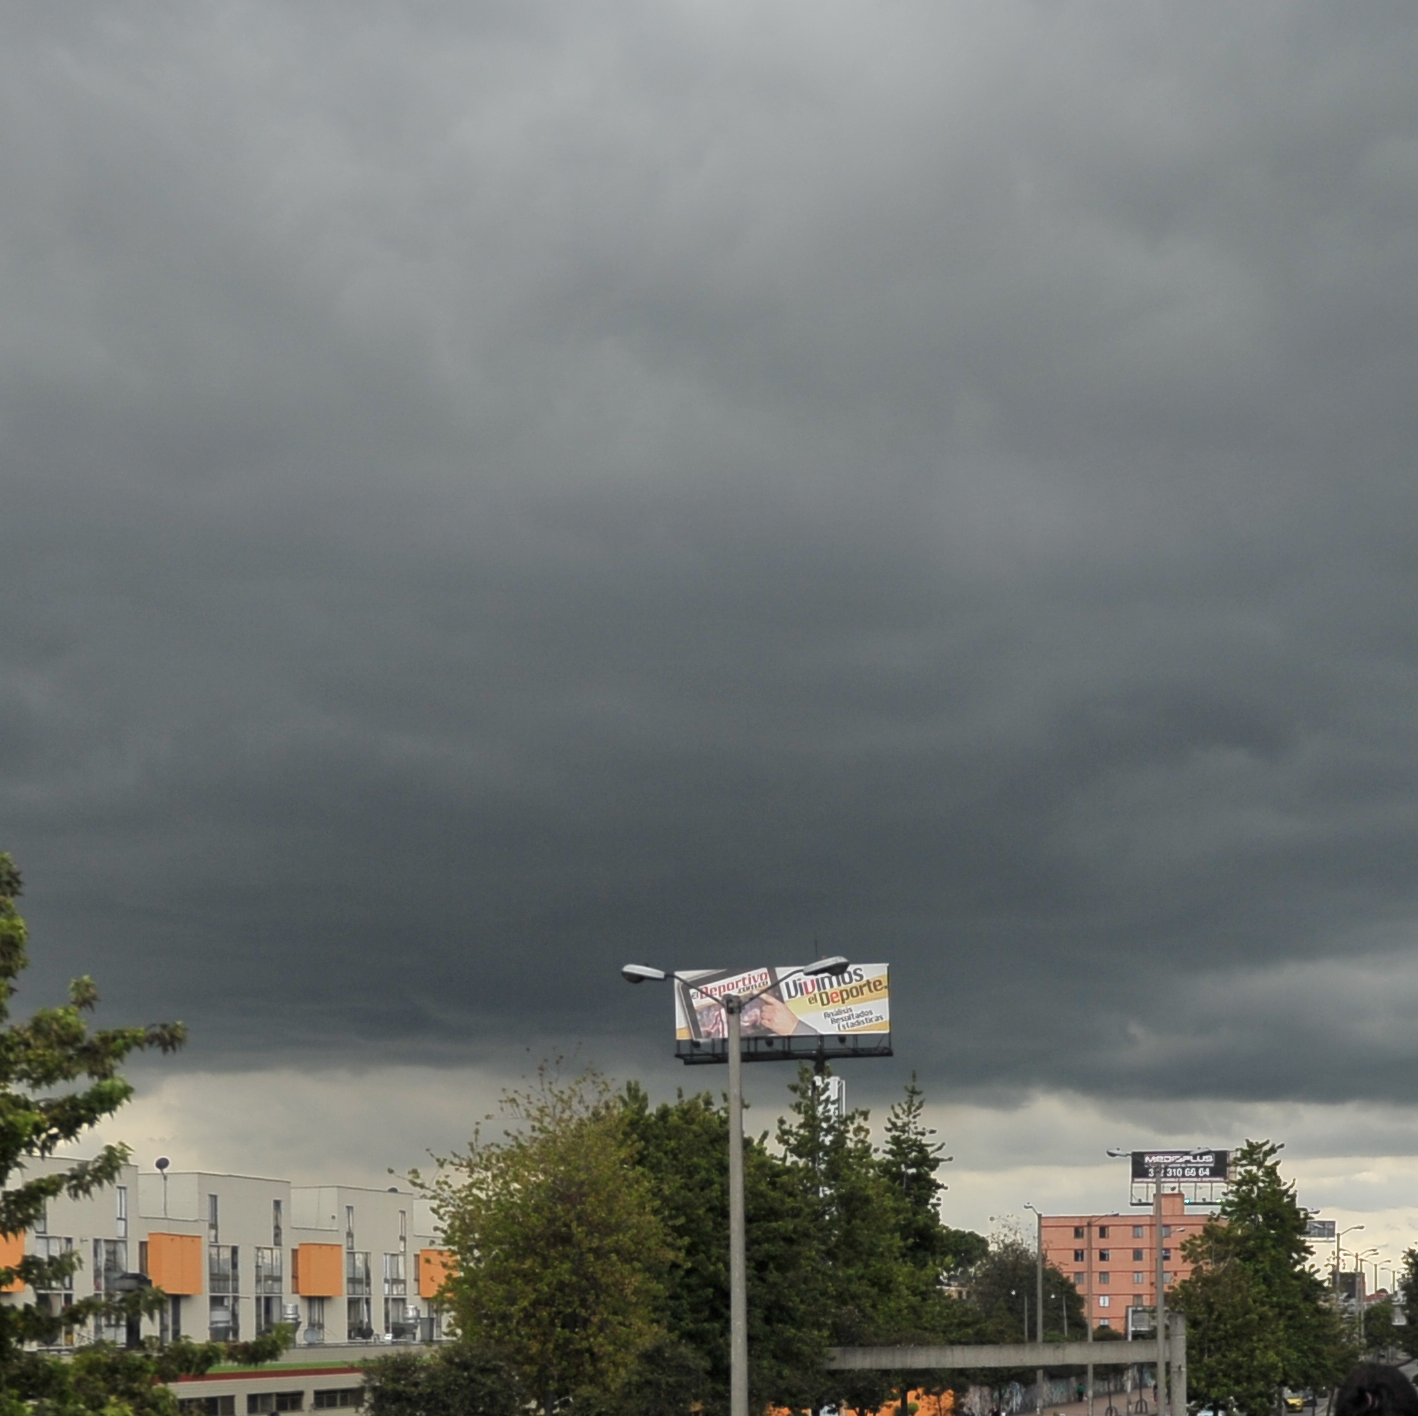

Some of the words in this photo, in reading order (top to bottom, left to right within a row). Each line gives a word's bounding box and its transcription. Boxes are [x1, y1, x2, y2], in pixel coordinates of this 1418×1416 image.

[699, 971, 769, 1000] Deportivo
[785, 967, 864, 999] Vivimos
[807, 995, 818, 1006] el
[819, 978, 889, 1007] Deporte.
[830, 1009, 874, 1025] Resultados
[1166, 1168, 1183, 1177] 310
